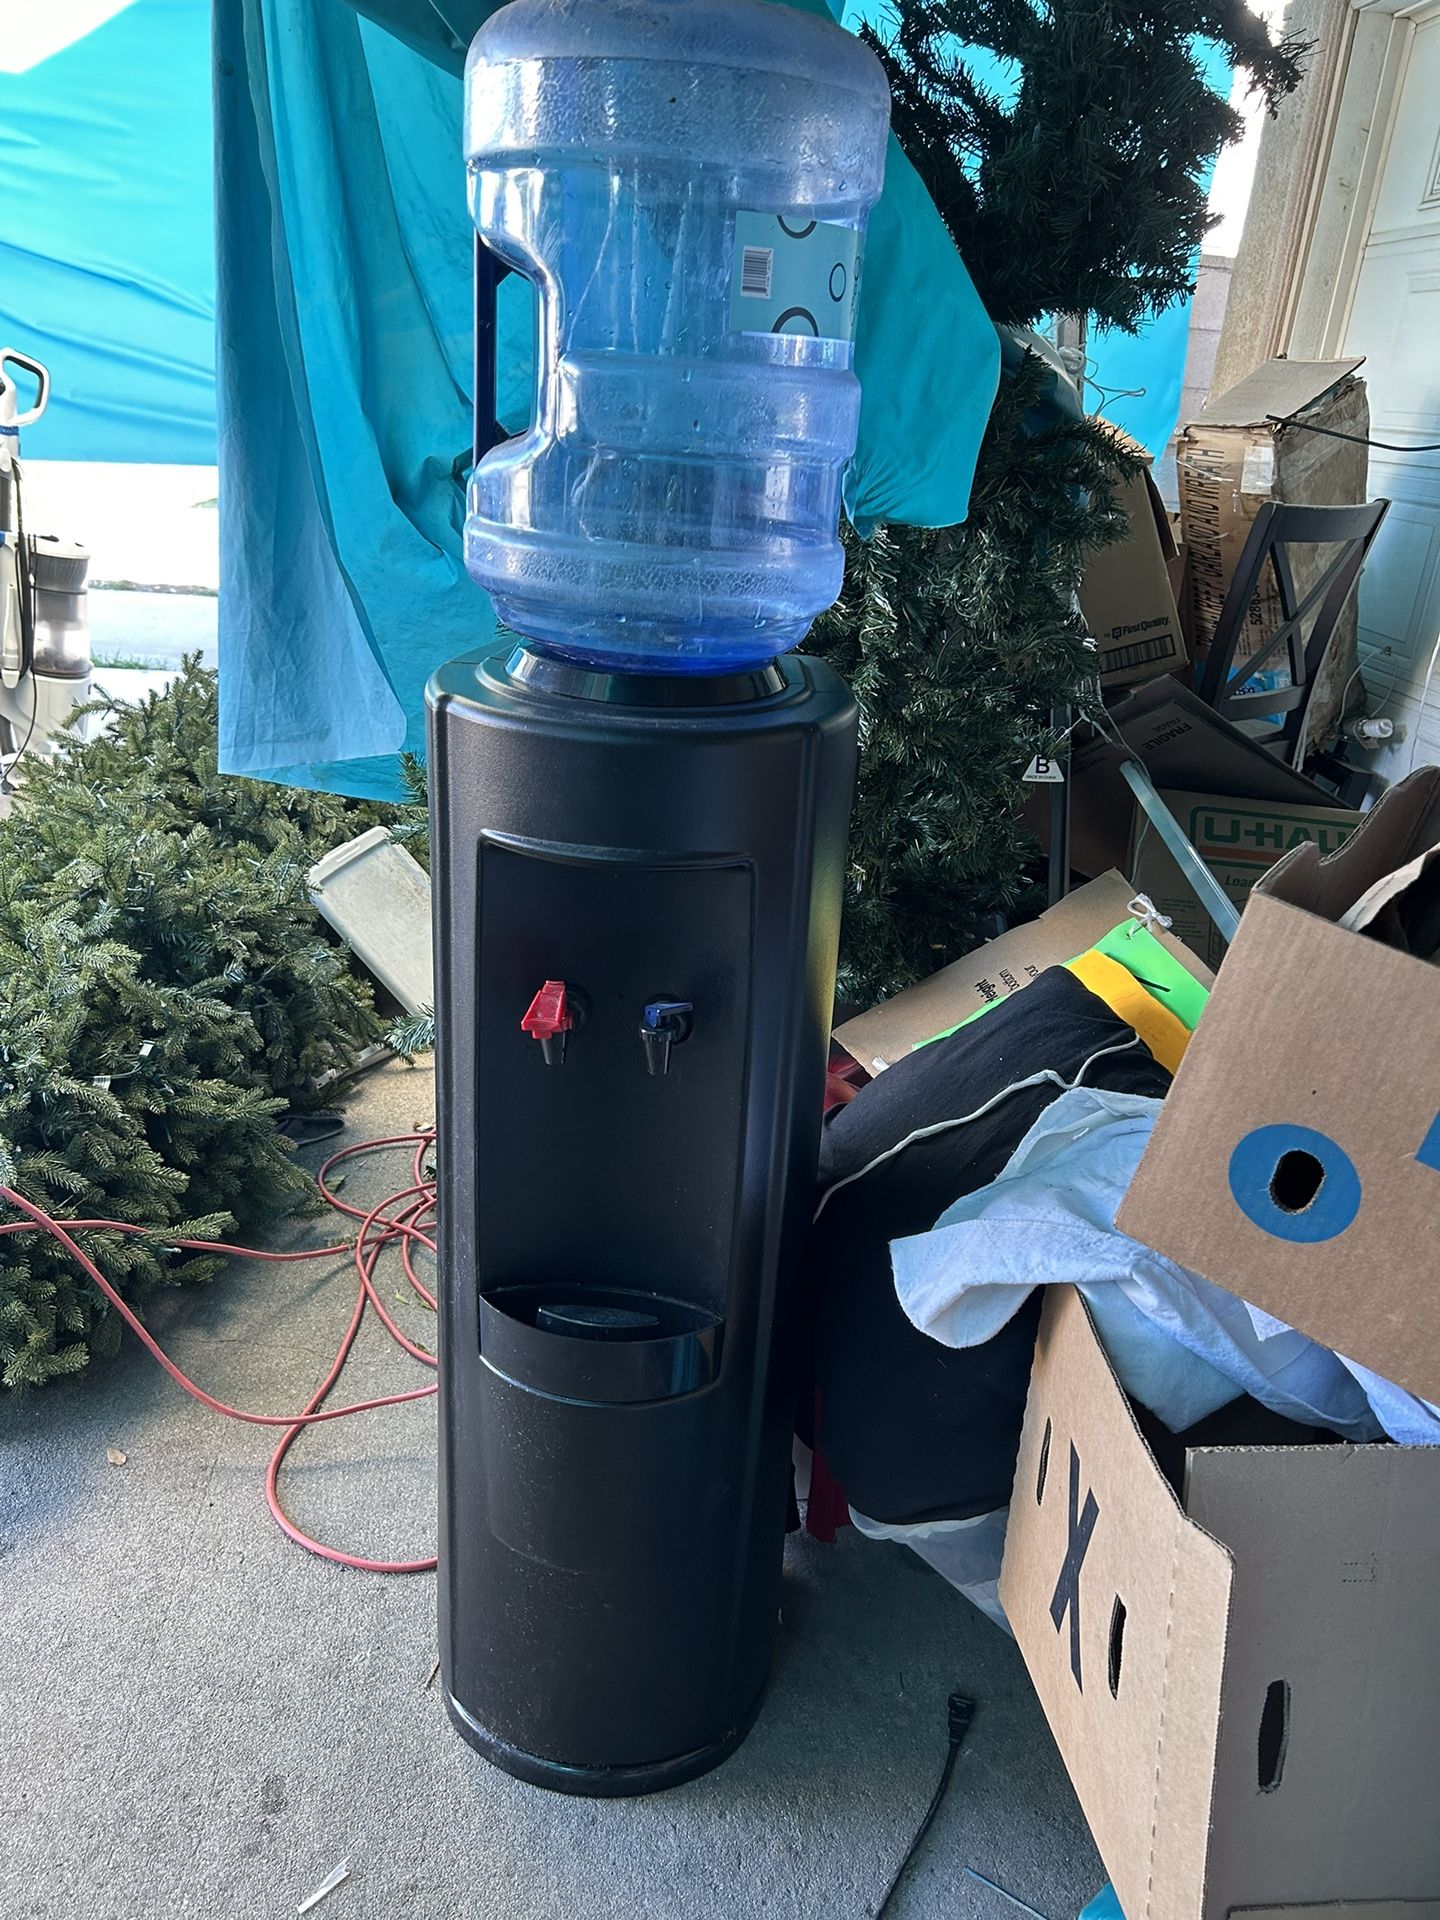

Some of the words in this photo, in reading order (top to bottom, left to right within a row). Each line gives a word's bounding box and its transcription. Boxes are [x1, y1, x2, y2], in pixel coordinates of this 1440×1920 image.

[1184, 447, 1225, 500] WREATH
[1186, 499, 1220, 527] AND
[1188, 524, 1223, 578] GARLAND
[1123, 624, 1140, 635] First
[1142, 722, 1192, 751] FRAGILE
[1036, 756, 1050, 774] B
[1204, 816, 1347, 856] U-HAU
